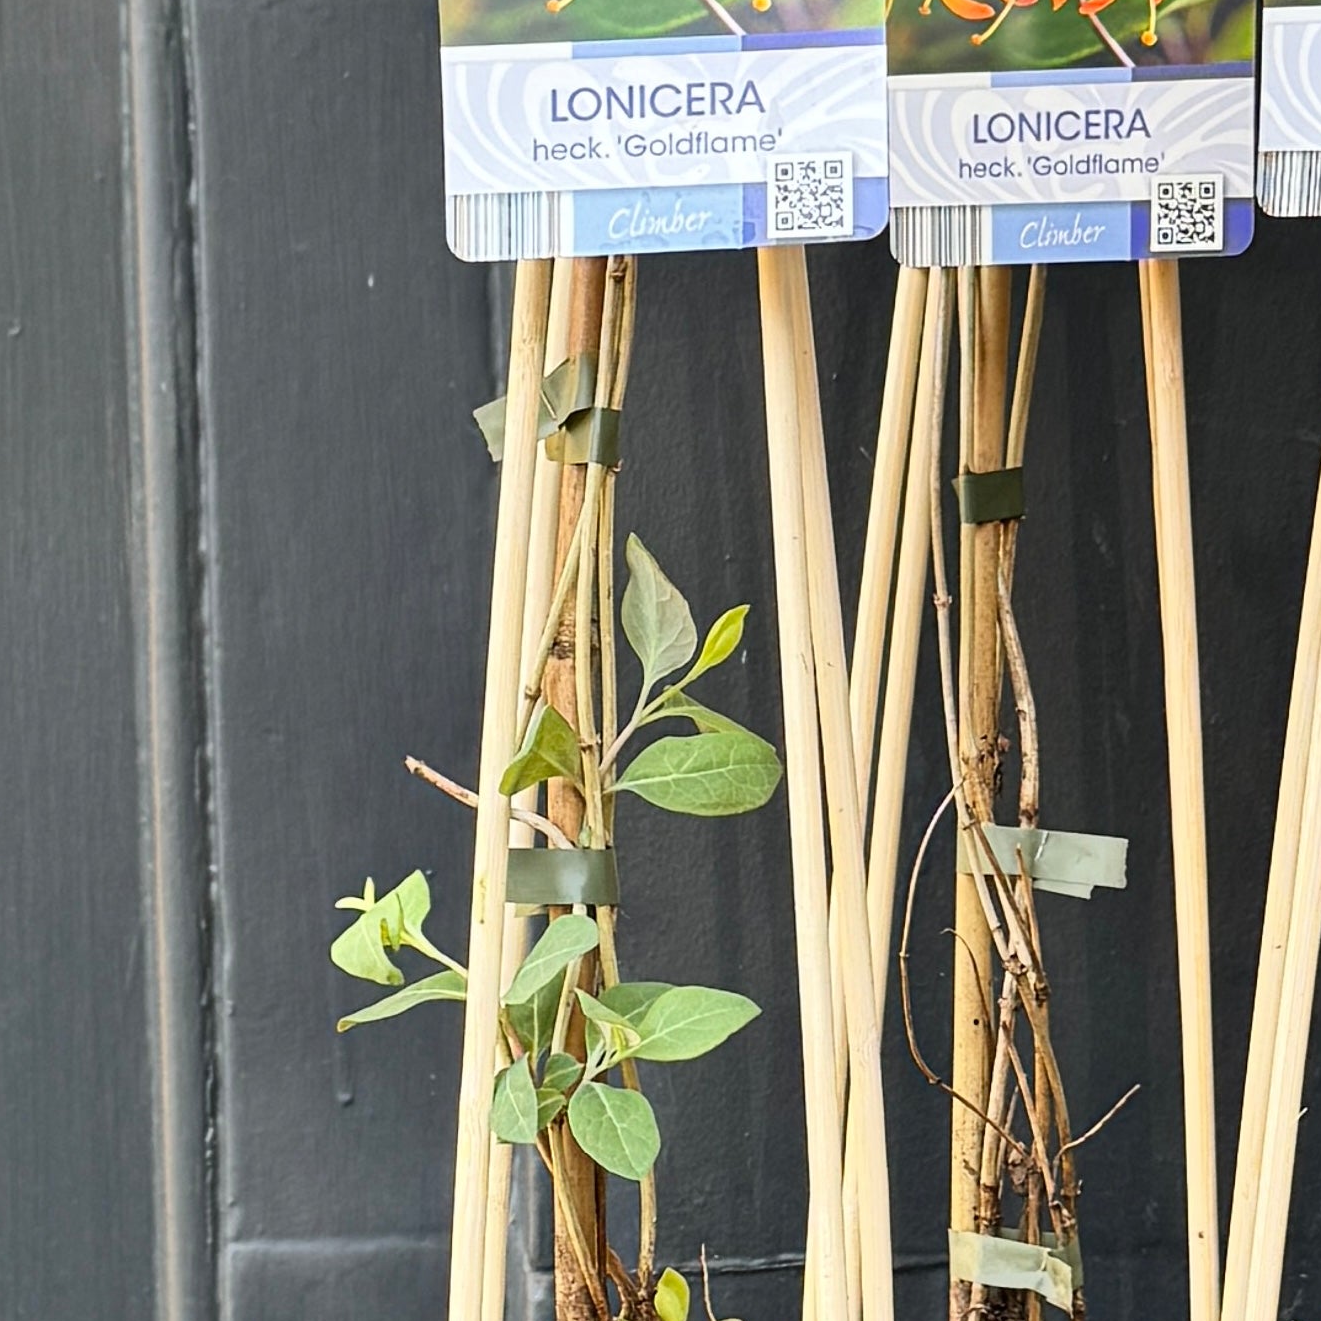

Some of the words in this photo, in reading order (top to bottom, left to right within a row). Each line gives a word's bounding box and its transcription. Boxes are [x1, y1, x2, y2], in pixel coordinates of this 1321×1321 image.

[551, 80, 766, 123] LONICERA
[973, 108, 1152, 144] LONICERA
[533, 138, 610, 162] heck.
[617, 128, 783, 158] 'Goldflame'
[959, 158, 1023, 179] heck.
[1027, 153, 1165, 176] 'Goldflame'
[608, 199, 712, 239] Climber
[1019, 213, 1106, 250] Climber
